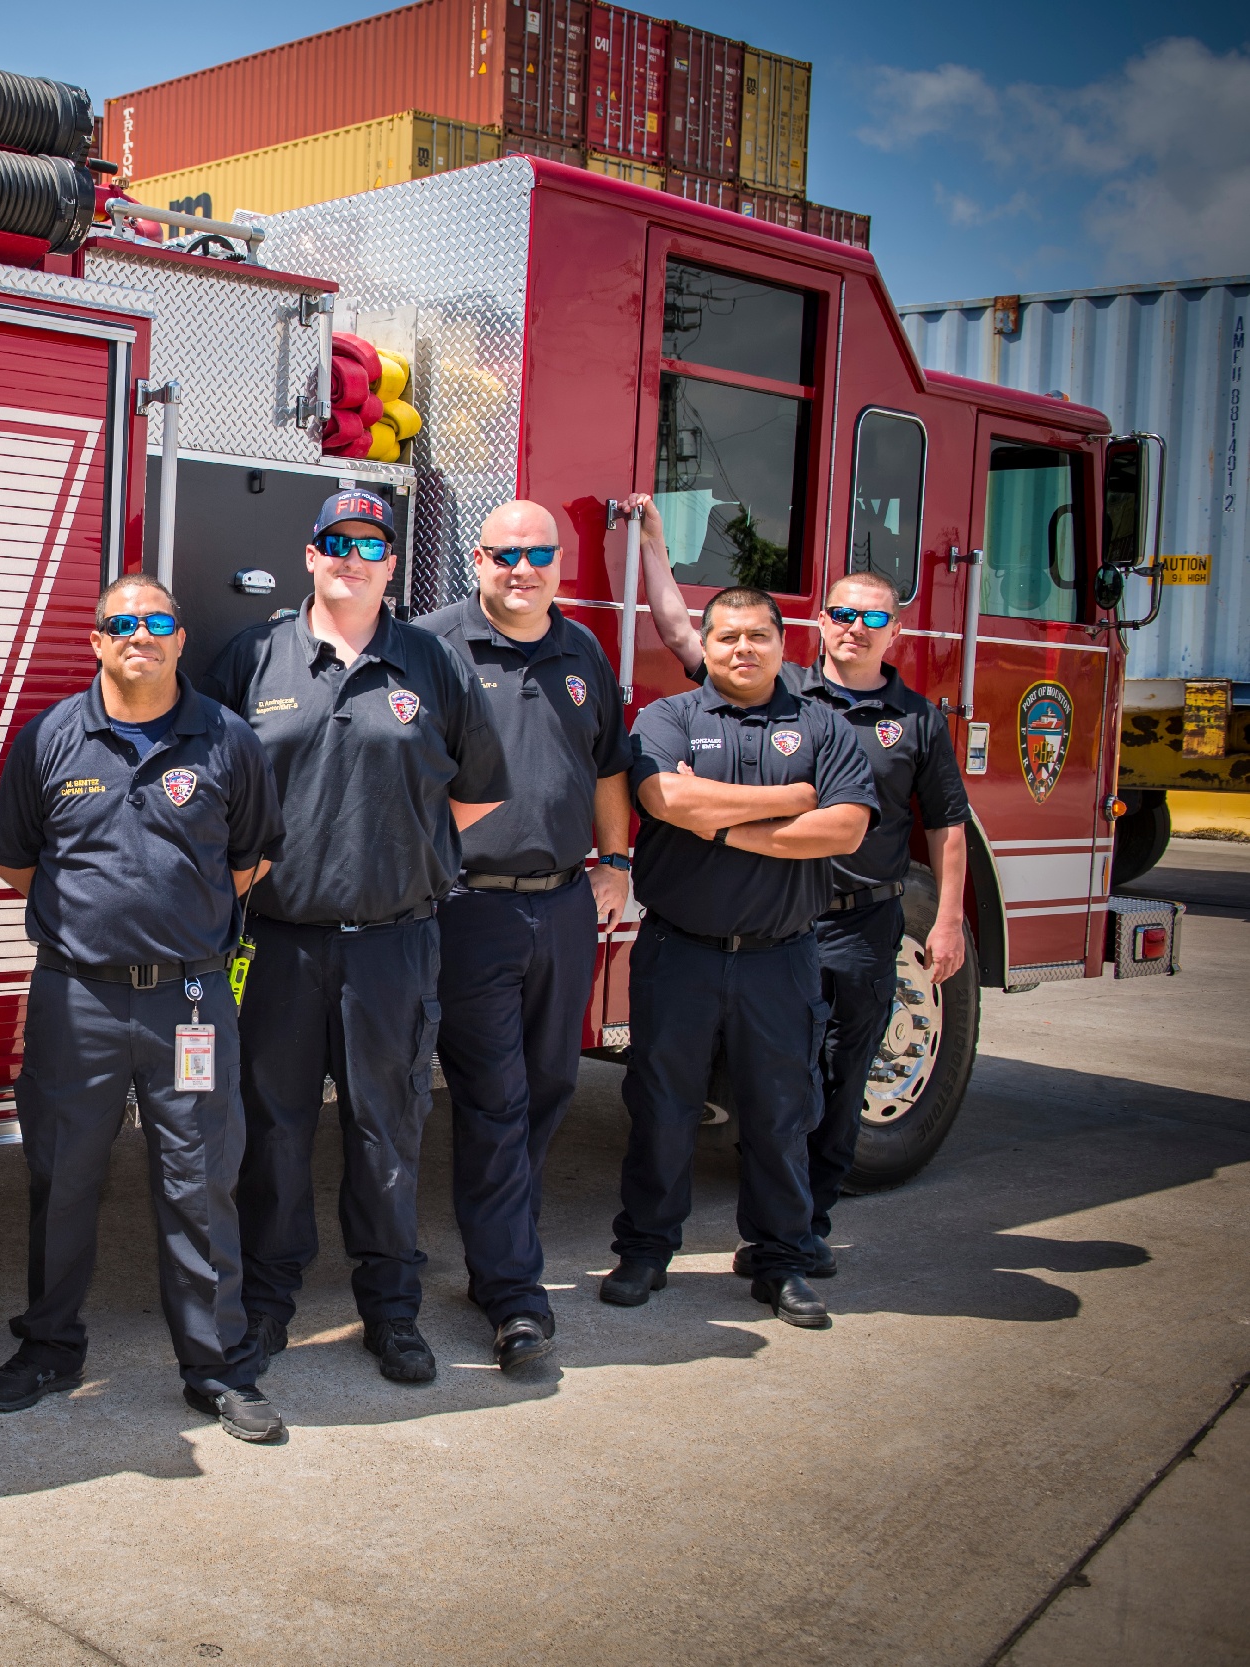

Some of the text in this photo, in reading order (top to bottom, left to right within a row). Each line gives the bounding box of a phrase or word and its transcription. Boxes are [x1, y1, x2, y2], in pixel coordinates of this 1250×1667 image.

[594, 36, 609, 52] CAI
[123, 107, 134, 178] TRITON
[335, 498, 384, 520] FIRE
[1224, 494, 1235, 512] 2
[1162, 557, 1207, 571] AUTION
[1188, 573, 1207, 582] HIGH
[1022, 686, 1072, 715] PORT OF HOUSTON
[1021, 727, 1035, 783] FIRE
[1032, 741, 1056, 764] PHA
[1047, 729, 1069, 786] DEPT
[73, 778, 100, 787] BENITEZ
